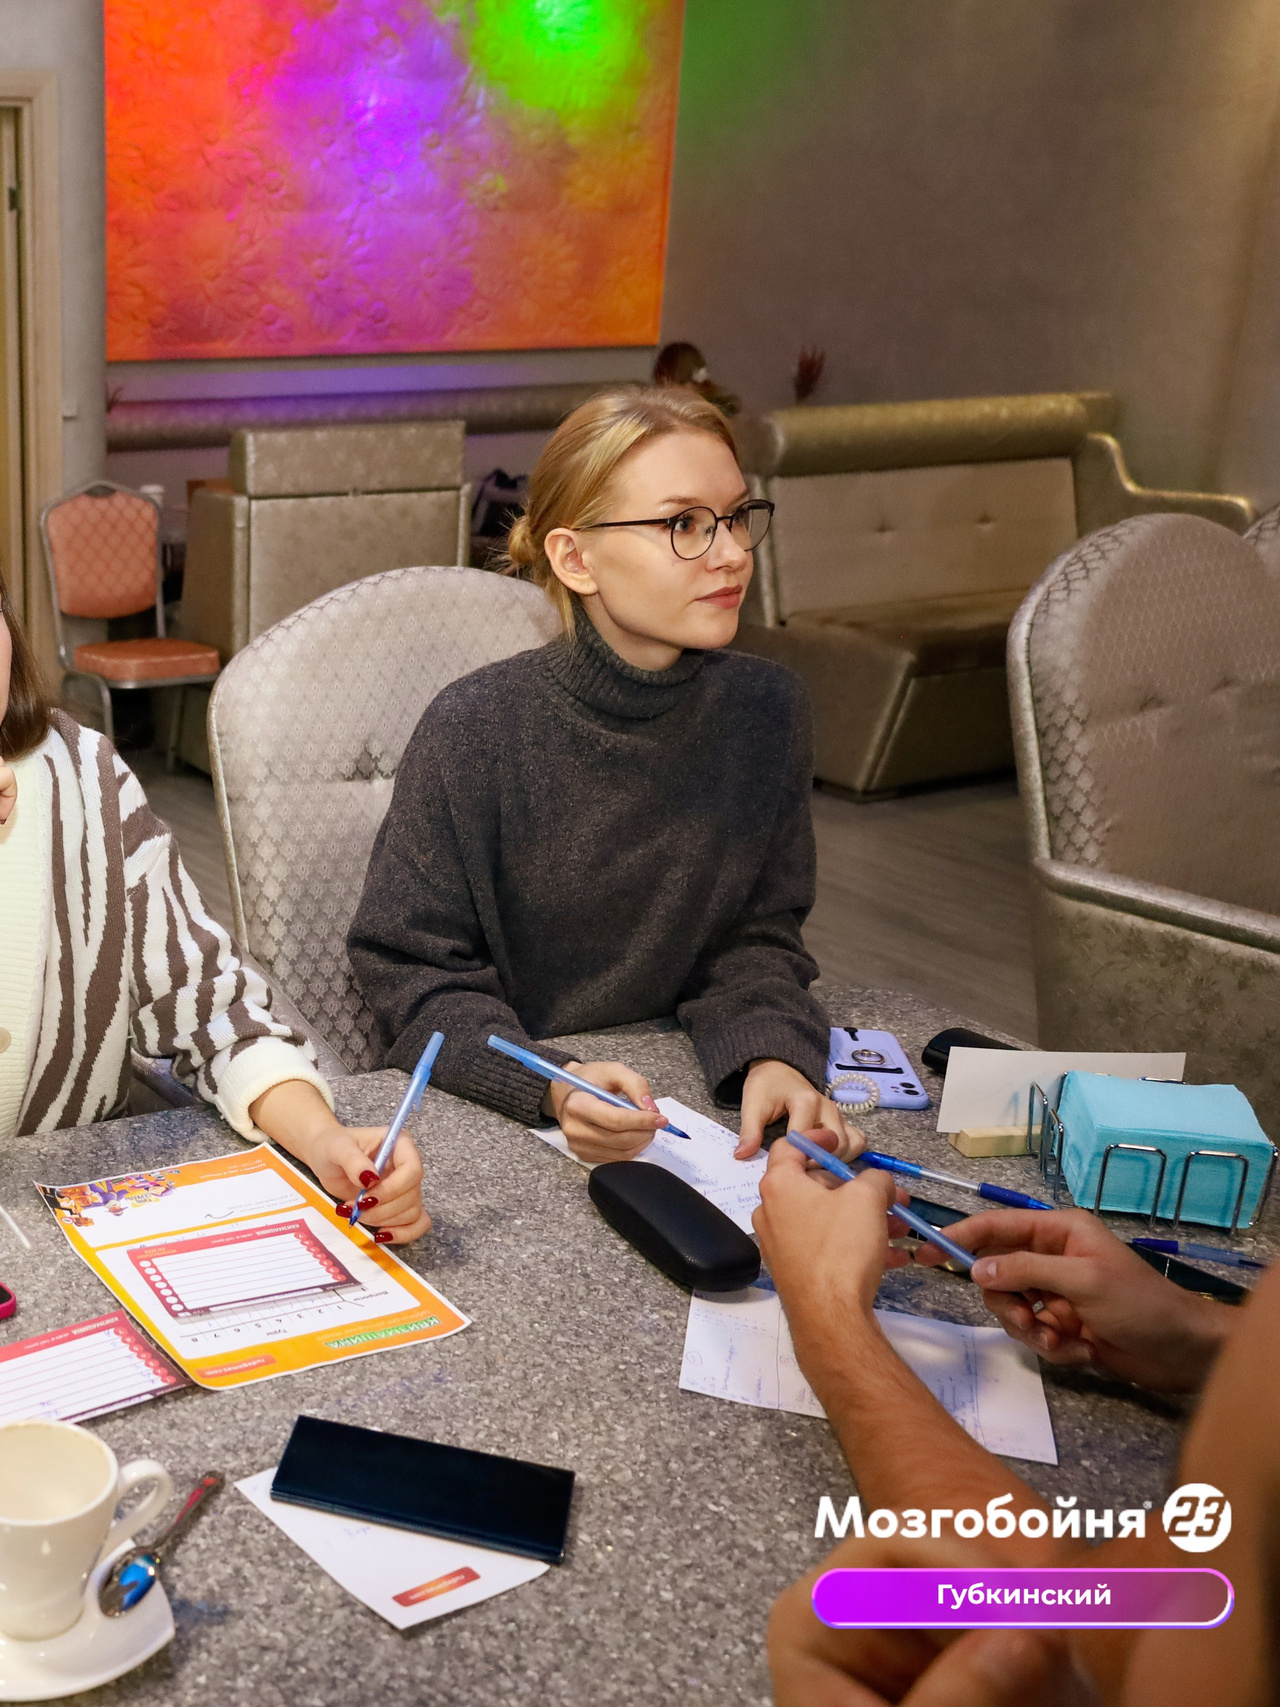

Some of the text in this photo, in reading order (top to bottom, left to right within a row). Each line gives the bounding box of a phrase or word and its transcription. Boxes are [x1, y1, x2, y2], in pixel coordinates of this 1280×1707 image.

[353, 1290, 389, 1302] Вопросы
[324, 1316, 441, 1348] КВИЗМАШИНА
[205, 1358, 266, 1376] rudagames.com
